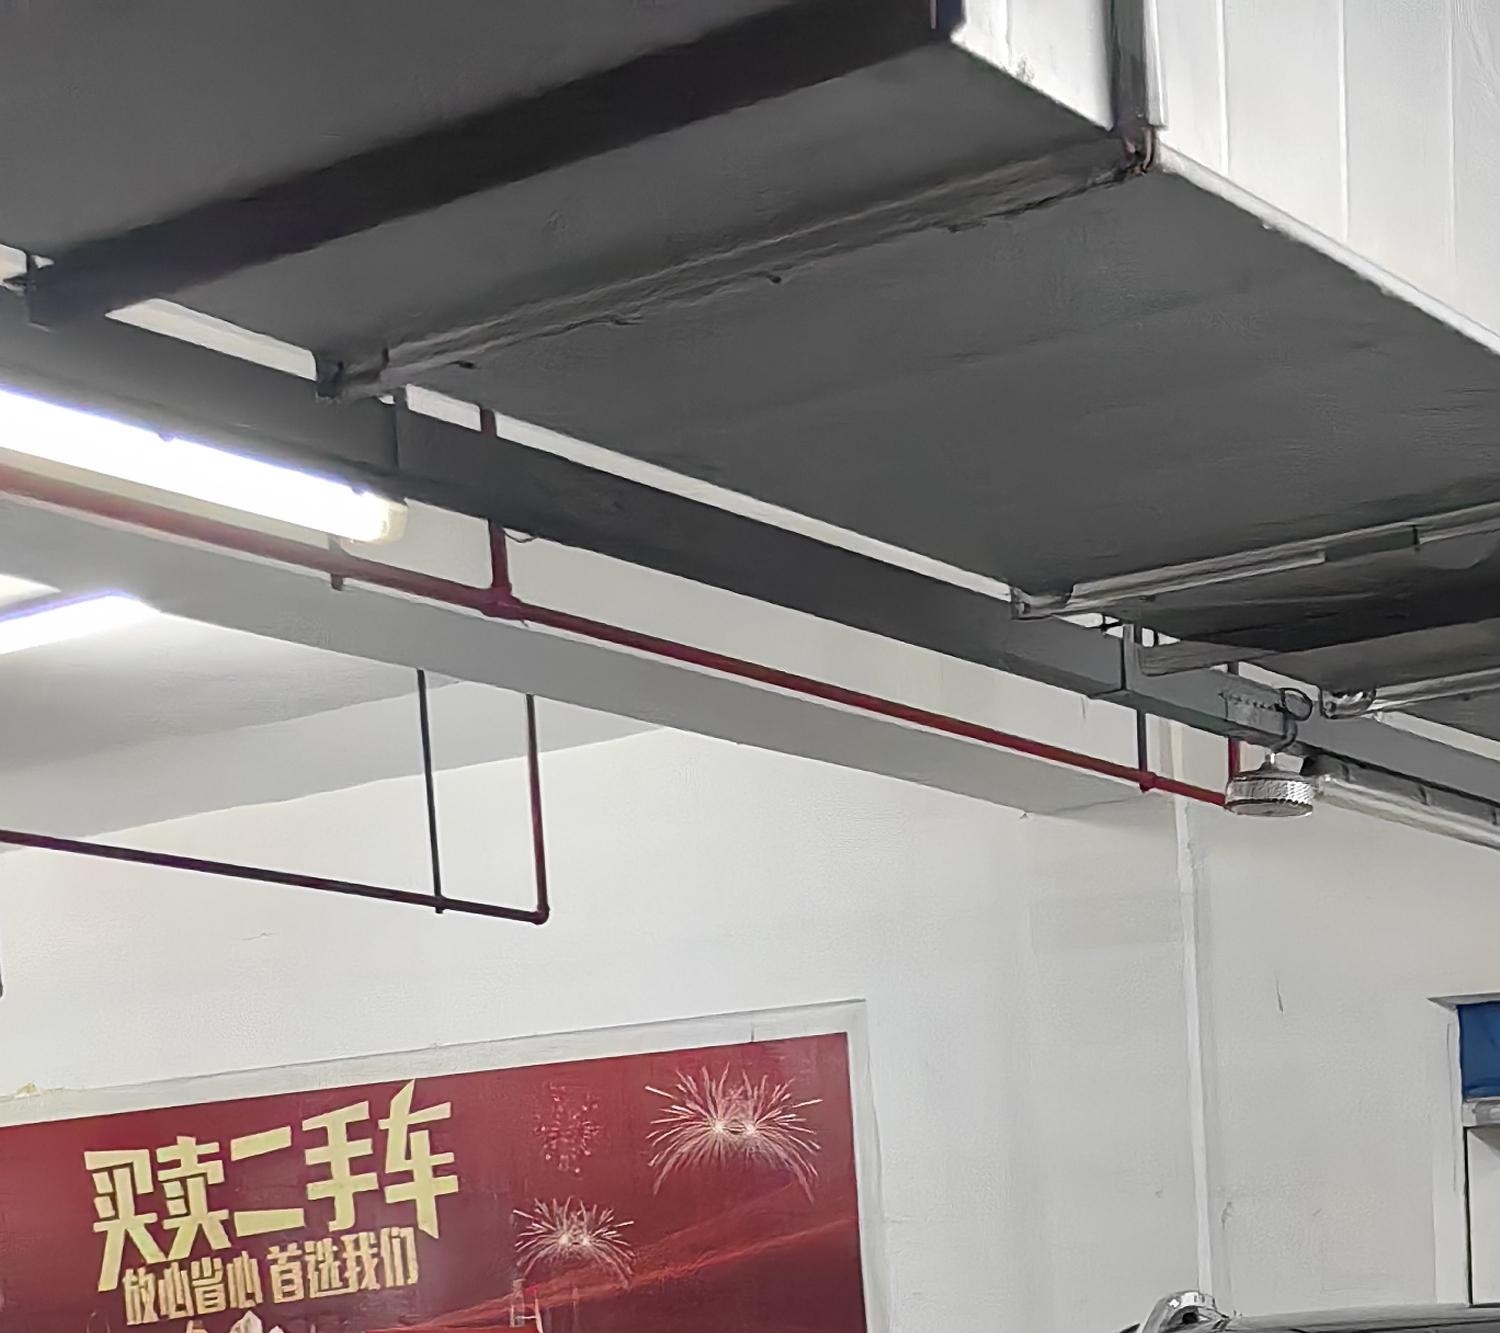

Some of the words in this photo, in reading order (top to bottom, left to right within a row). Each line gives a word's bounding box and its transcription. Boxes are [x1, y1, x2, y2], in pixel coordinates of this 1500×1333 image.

[84, 1079, 459, 1292] 买卖二手车
[122, 1251, 263, 1326] 放心省心
[267, 1226, 419, 1304] 首选我们
